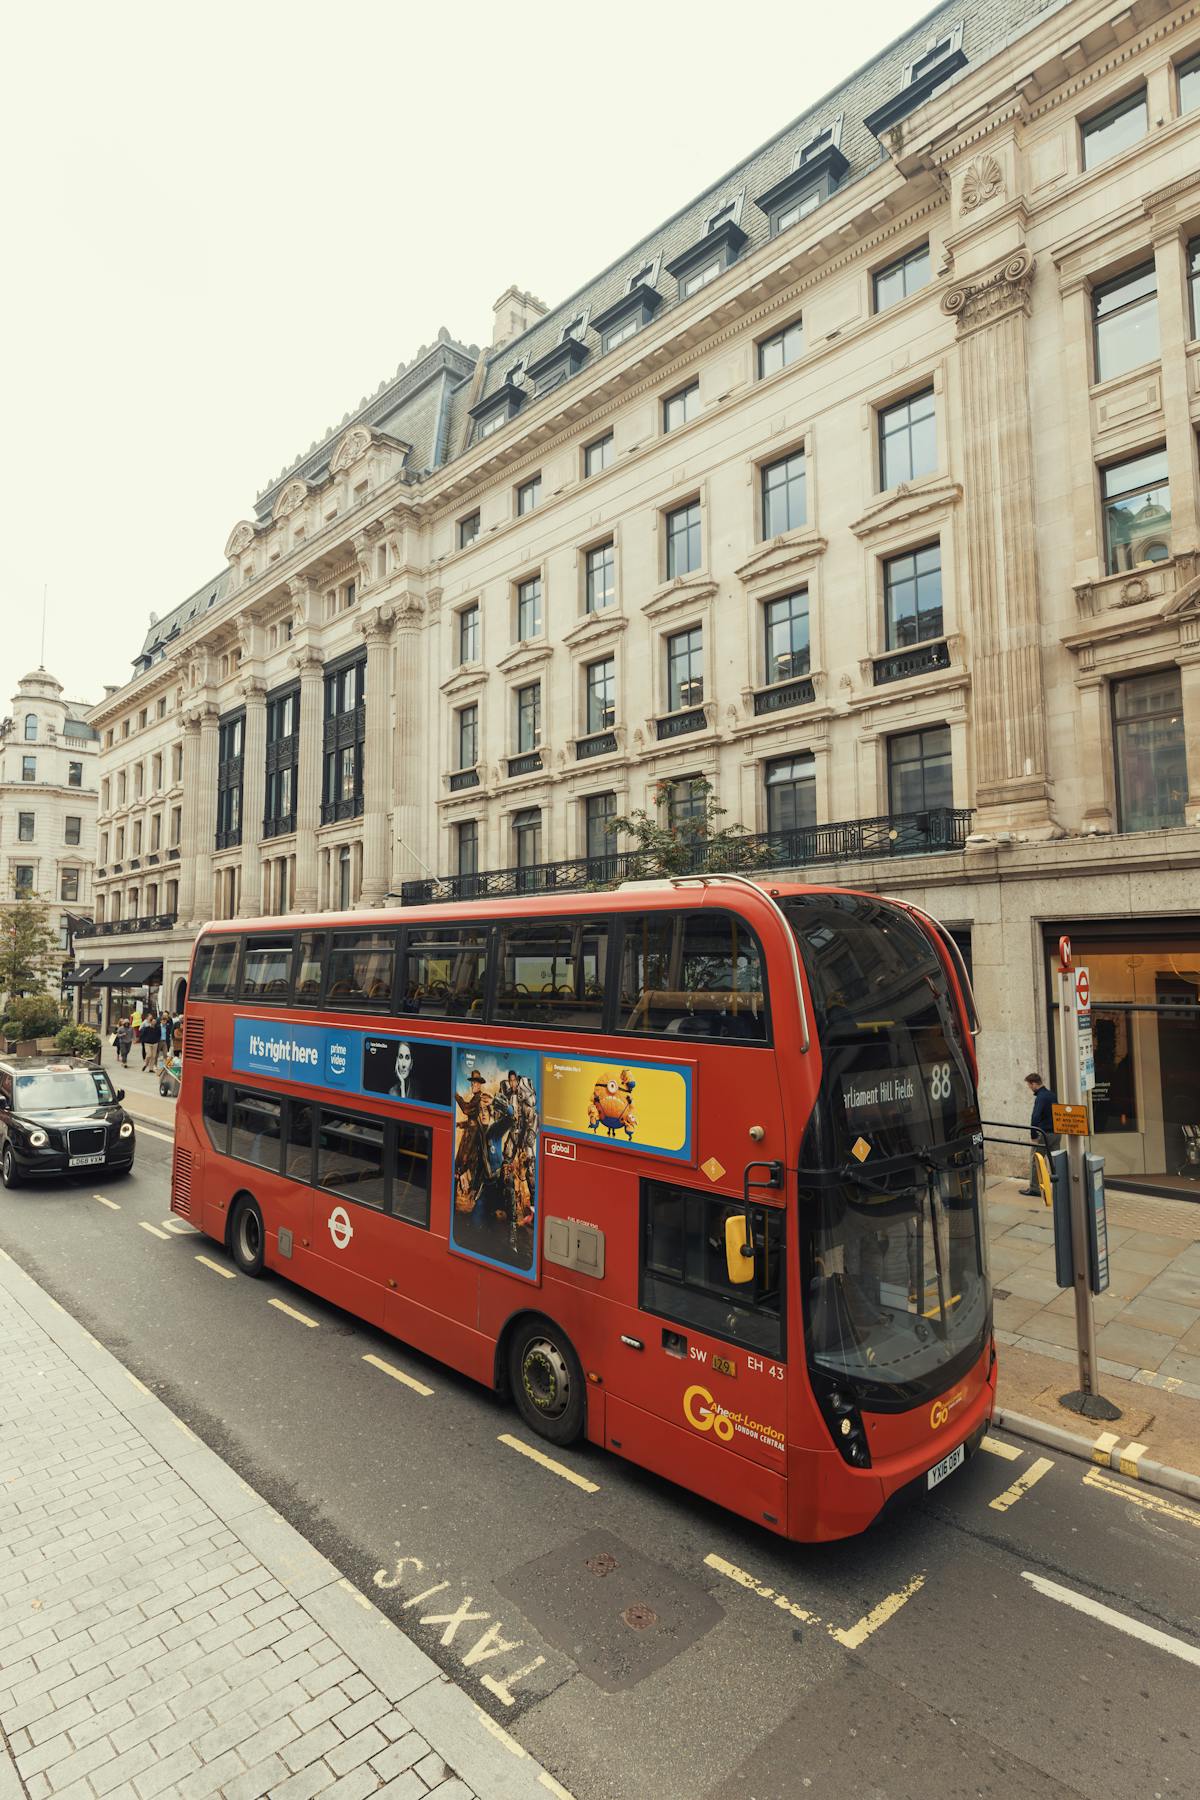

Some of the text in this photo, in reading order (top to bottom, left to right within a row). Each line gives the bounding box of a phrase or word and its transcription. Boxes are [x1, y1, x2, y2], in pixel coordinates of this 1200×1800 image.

[249, 1035, 318, 1065] It's right here
[330, 1043, 347, 1055] prime
[330, 1054, 346, 1066] video
[843, 1079, 914, 1109] arliament Hill Fields
[931, 1063, 951, 1100] 88
[551, 1142, 570, 1154] global
[690, 1347, 707, 1362] SW
[747, 1356, 764, 1373] EH
[768, 1366, 784, 1380] 43
[683, 1384, 785, 1441] Go Ahead-London
[930, 1401, 948, 1429] Go
[734, 1423, 785, 1451] LONDON CENTRAL
[932, 1460, 948, 1483] YX16
[372, 1556, 546, 1706] TAXIS
